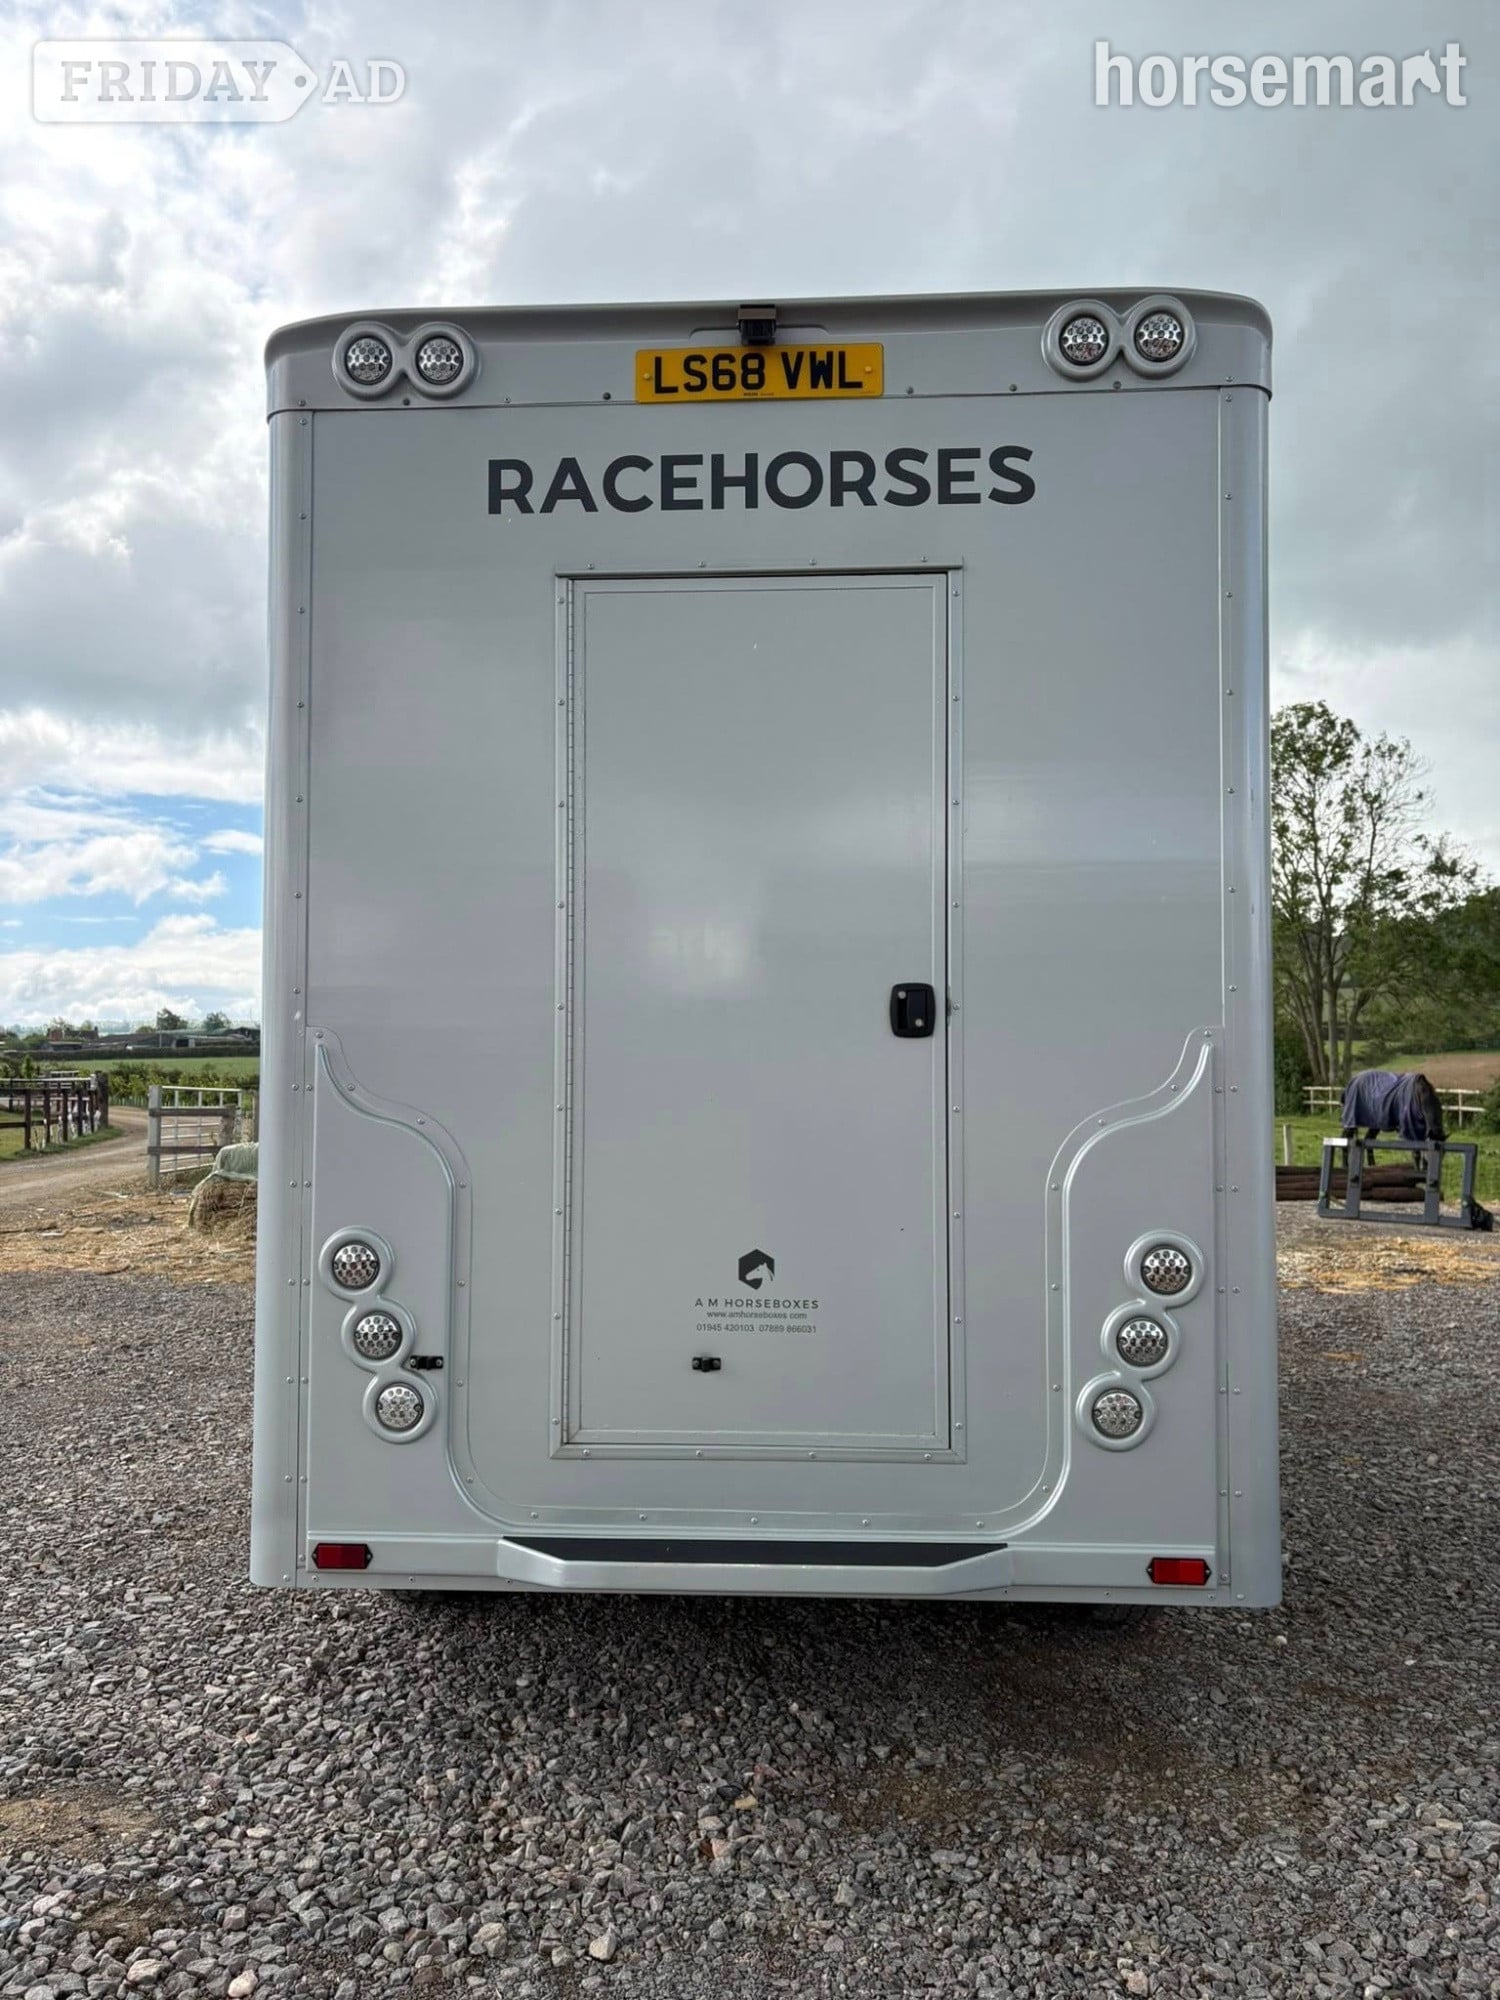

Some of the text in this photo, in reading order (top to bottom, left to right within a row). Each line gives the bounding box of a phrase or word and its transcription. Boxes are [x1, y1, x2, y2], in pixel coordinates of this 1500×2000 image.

[655, 351, 863, 394] LS68 VWL
[488, 445, 1036, 515] RACEHORSES
[694, 1298, 819, 1309] A M HORSEBOXES
[696, 1323, 721, 1331] 01945
